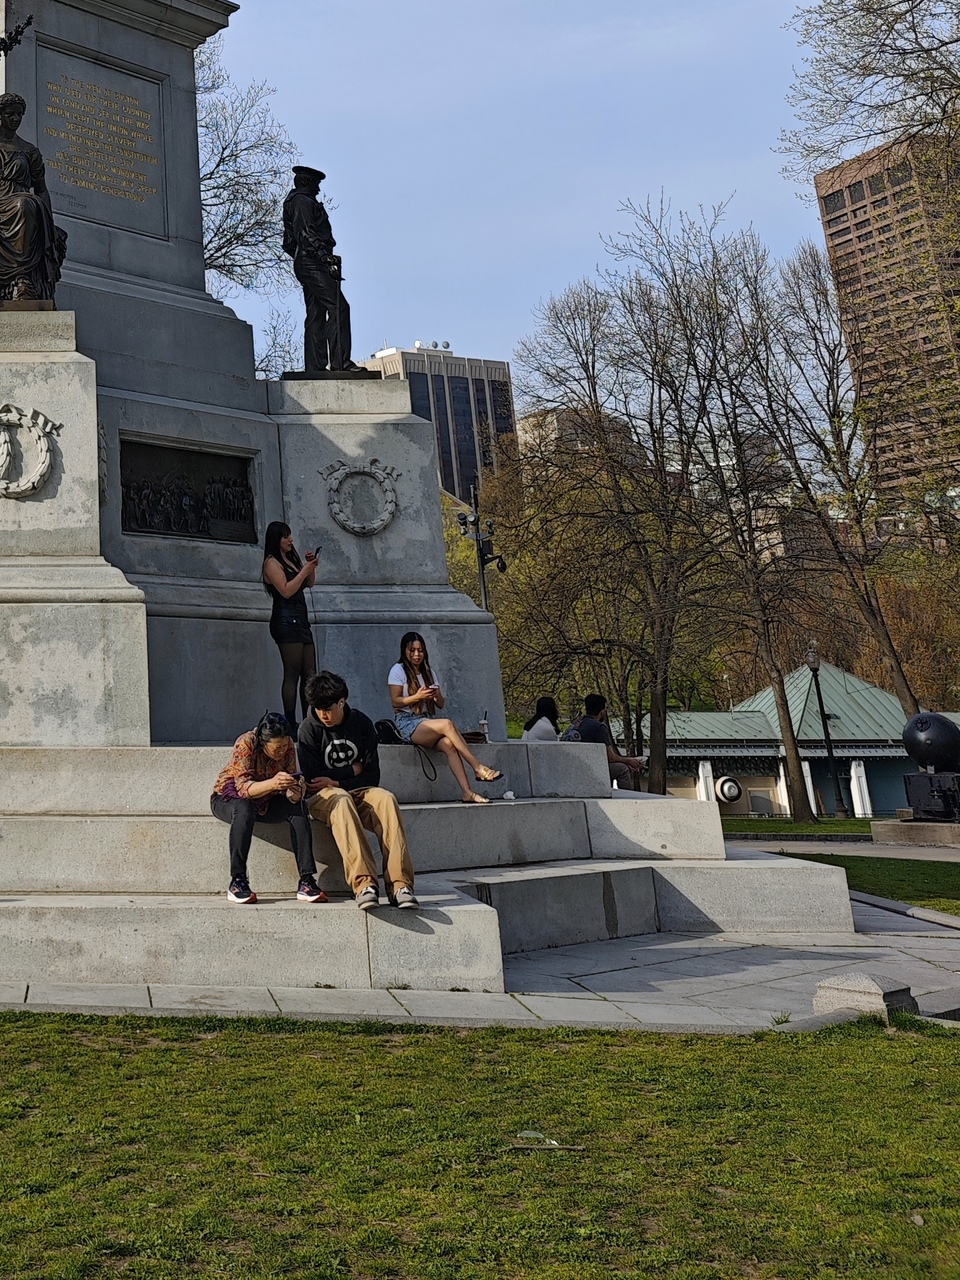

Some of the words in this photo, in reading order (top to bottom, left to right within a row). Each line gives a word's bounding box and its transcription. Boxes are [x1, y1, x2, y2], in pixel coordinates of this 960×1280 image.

[47, 82, 62, 93] WHO
[65, 87, 81, 99] DIED
[84, 93, 97, 103] FOR
[100, 98, 120, 110] THEIR
[123, 106, 152, 120] COUNTRY
[71, 78, 84, 89] THE
[87, 84, 101, 95] MEN
[104, 89, 112, 97] OF
[115, 92, 140, 106] BOSTON
[46, 104, 70, 118] WHICH
[73, 113, 91, 124] KEPT
[93, 118, 105, 128] THE
[108, 124, 129, 136] UNION
[131, 131, 154, 144] WHOLE
[50, 95, 60, 104] ON
[63, 99, 80, 110] LAND
[82, 105, 95, 115] AND
[113, 113, 121, 122] IN
[122, 116, 135, 126] THE
[44, 127, 58, 137] AND
[60, 132, 100, 149] MAINTAINED
[102, 143, 114, 152] THE
[116, 148, 159, 165] CONSTITUTION
[66, 122, 104, 139] DESTROYED
[107, 134, 137, 150] SLAVERY
[56, 151, 70, 161] HAS
[94, 162, 108, 172] THIS
[111, 167, 148, 182] MONUMENT
[69, 144, 81, 153] THE
[85, 149, 117, 164] GRATEFUL
[59, 174, 68, 184] TO
[72, 178, 98, 191] COMING
[101, 185, 146, 203] GENERATIONS
[66, 165, 86, 176] THEIR
[89, 171, 119, 186] EXAMPLE
[137, 184, 158, 195] SPEAK
